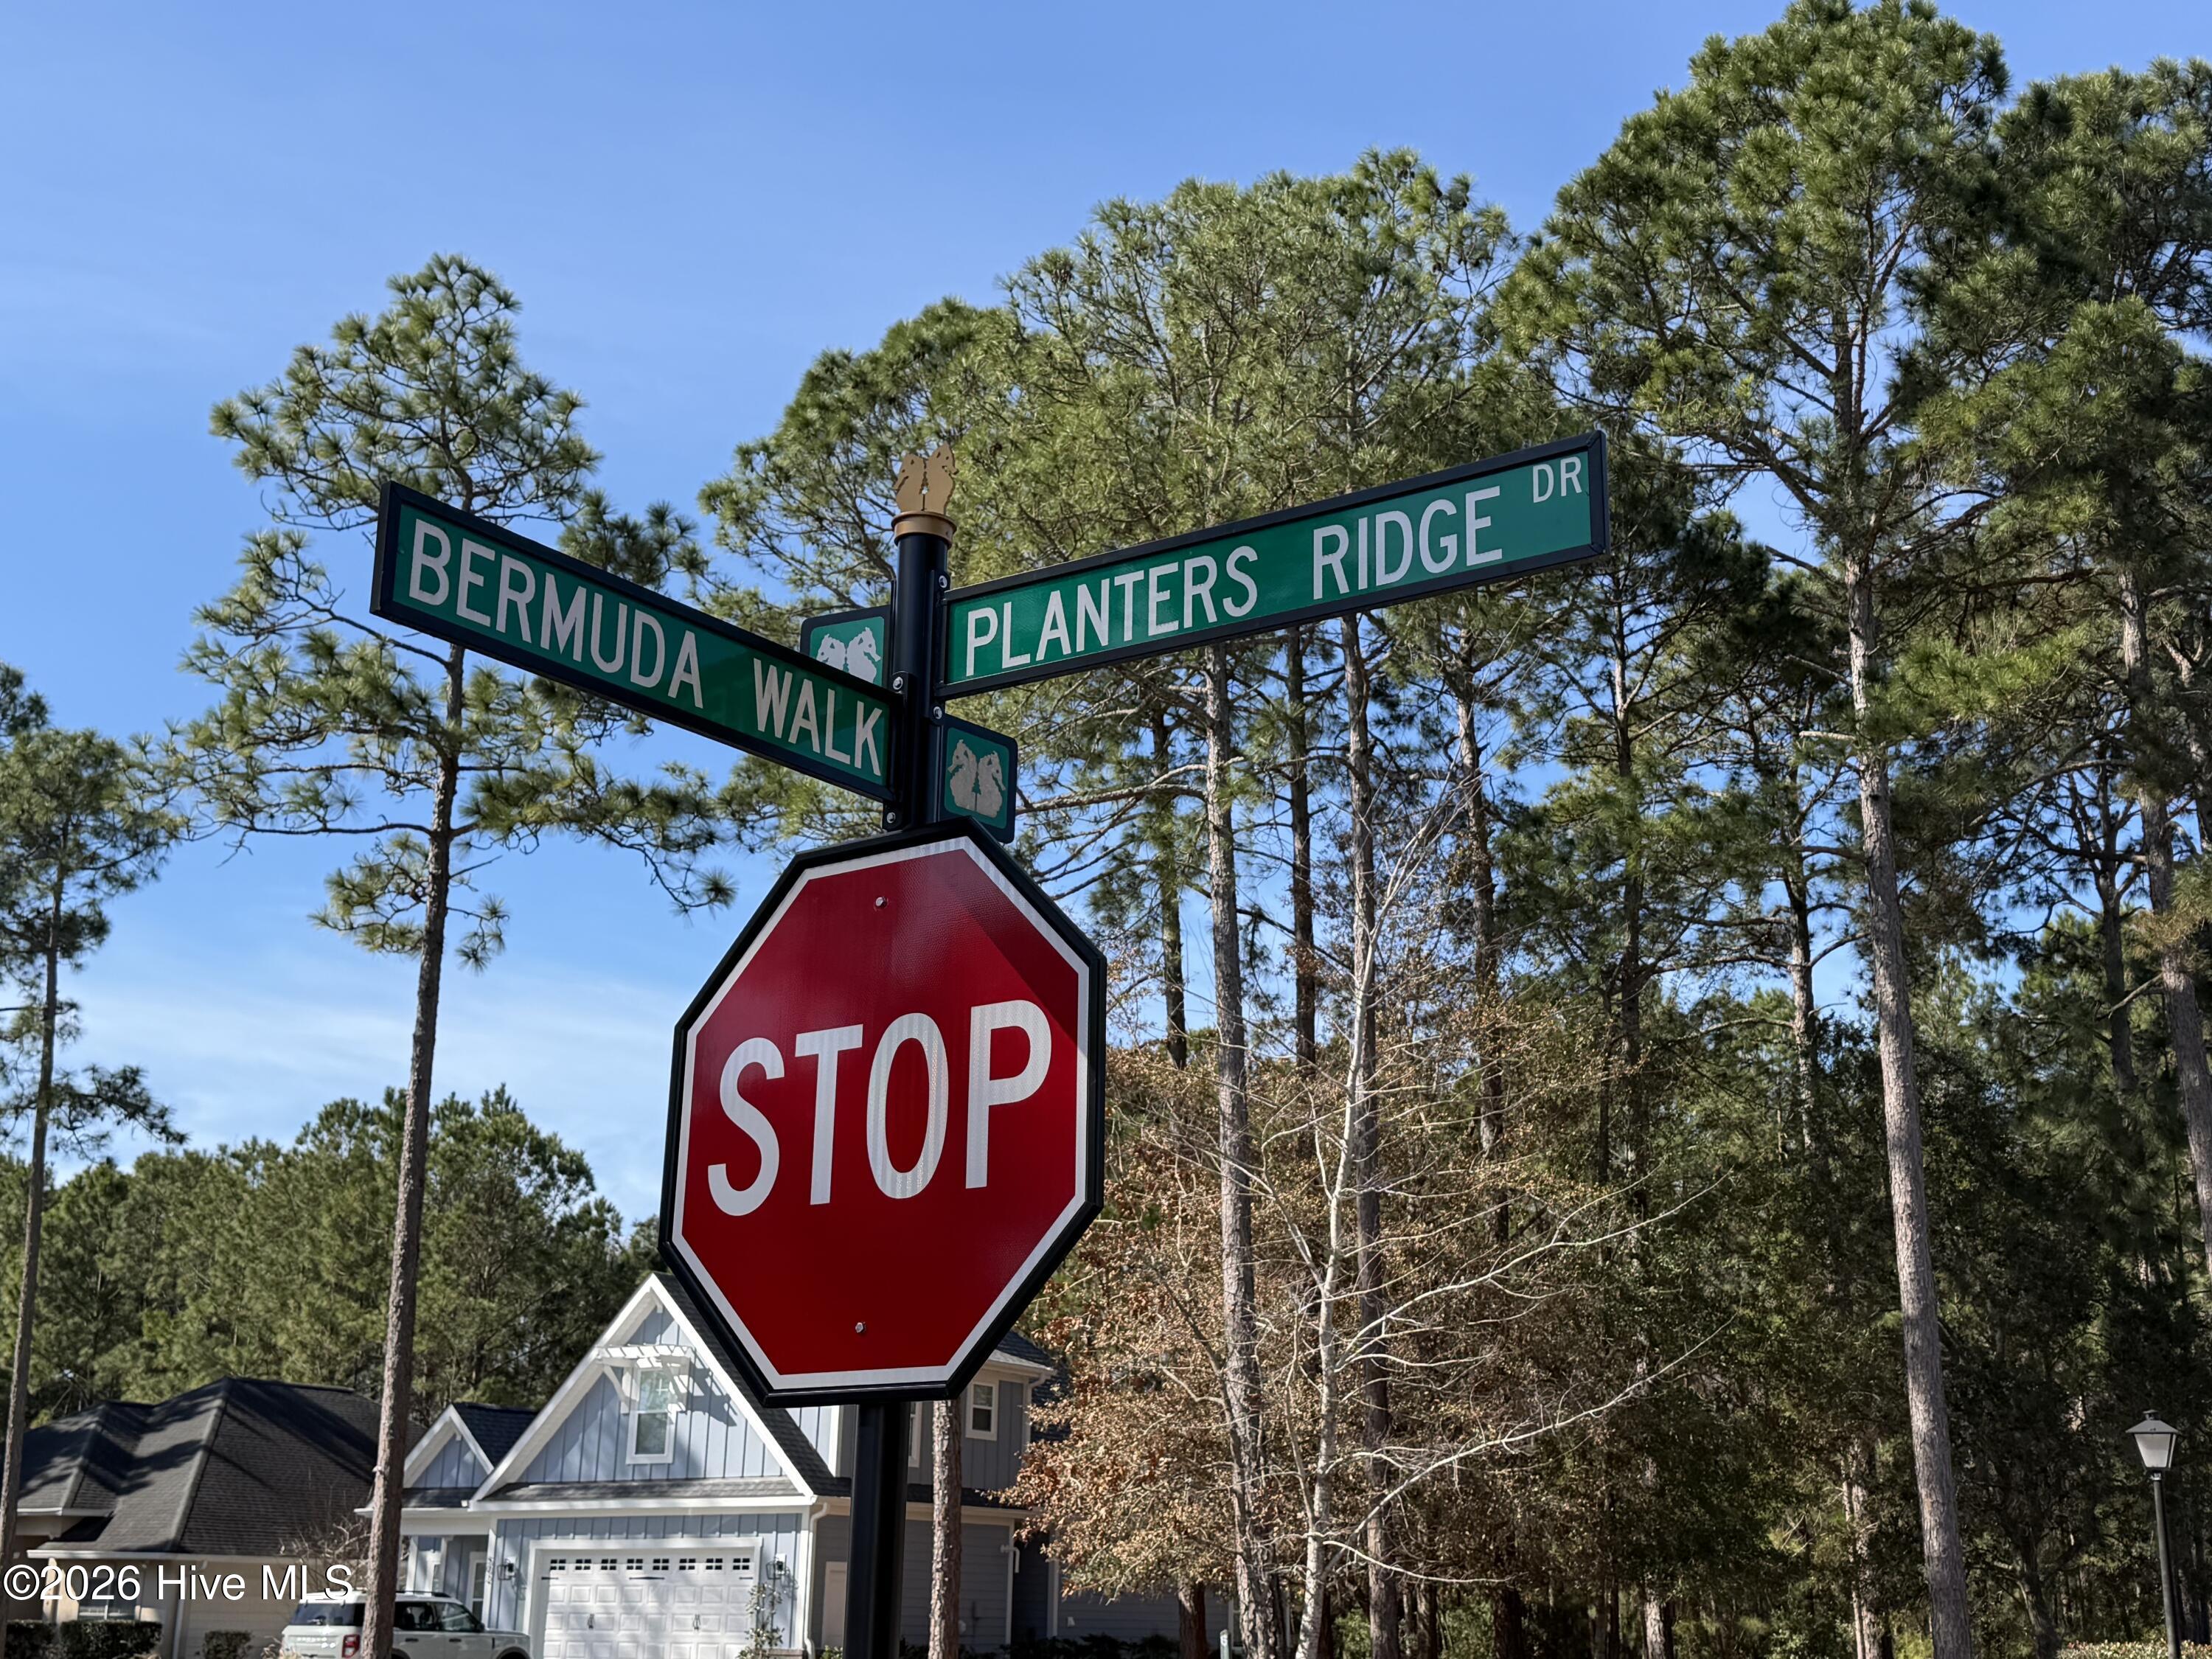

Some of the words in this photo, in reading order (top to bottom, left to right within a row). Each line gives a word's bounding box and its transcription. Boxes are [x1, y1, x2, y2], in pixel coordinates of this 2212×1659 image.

[408, 518, 703, 709] BERMUDA
[753, 658, 883, 776] WALK
[965, 545, 1258, 677] PLANTERS
[1312, 485, 1503, 599] RIDGE
[1531, 456, 1583, 503] DR
[707, 999, 1051, 1216] STOP
